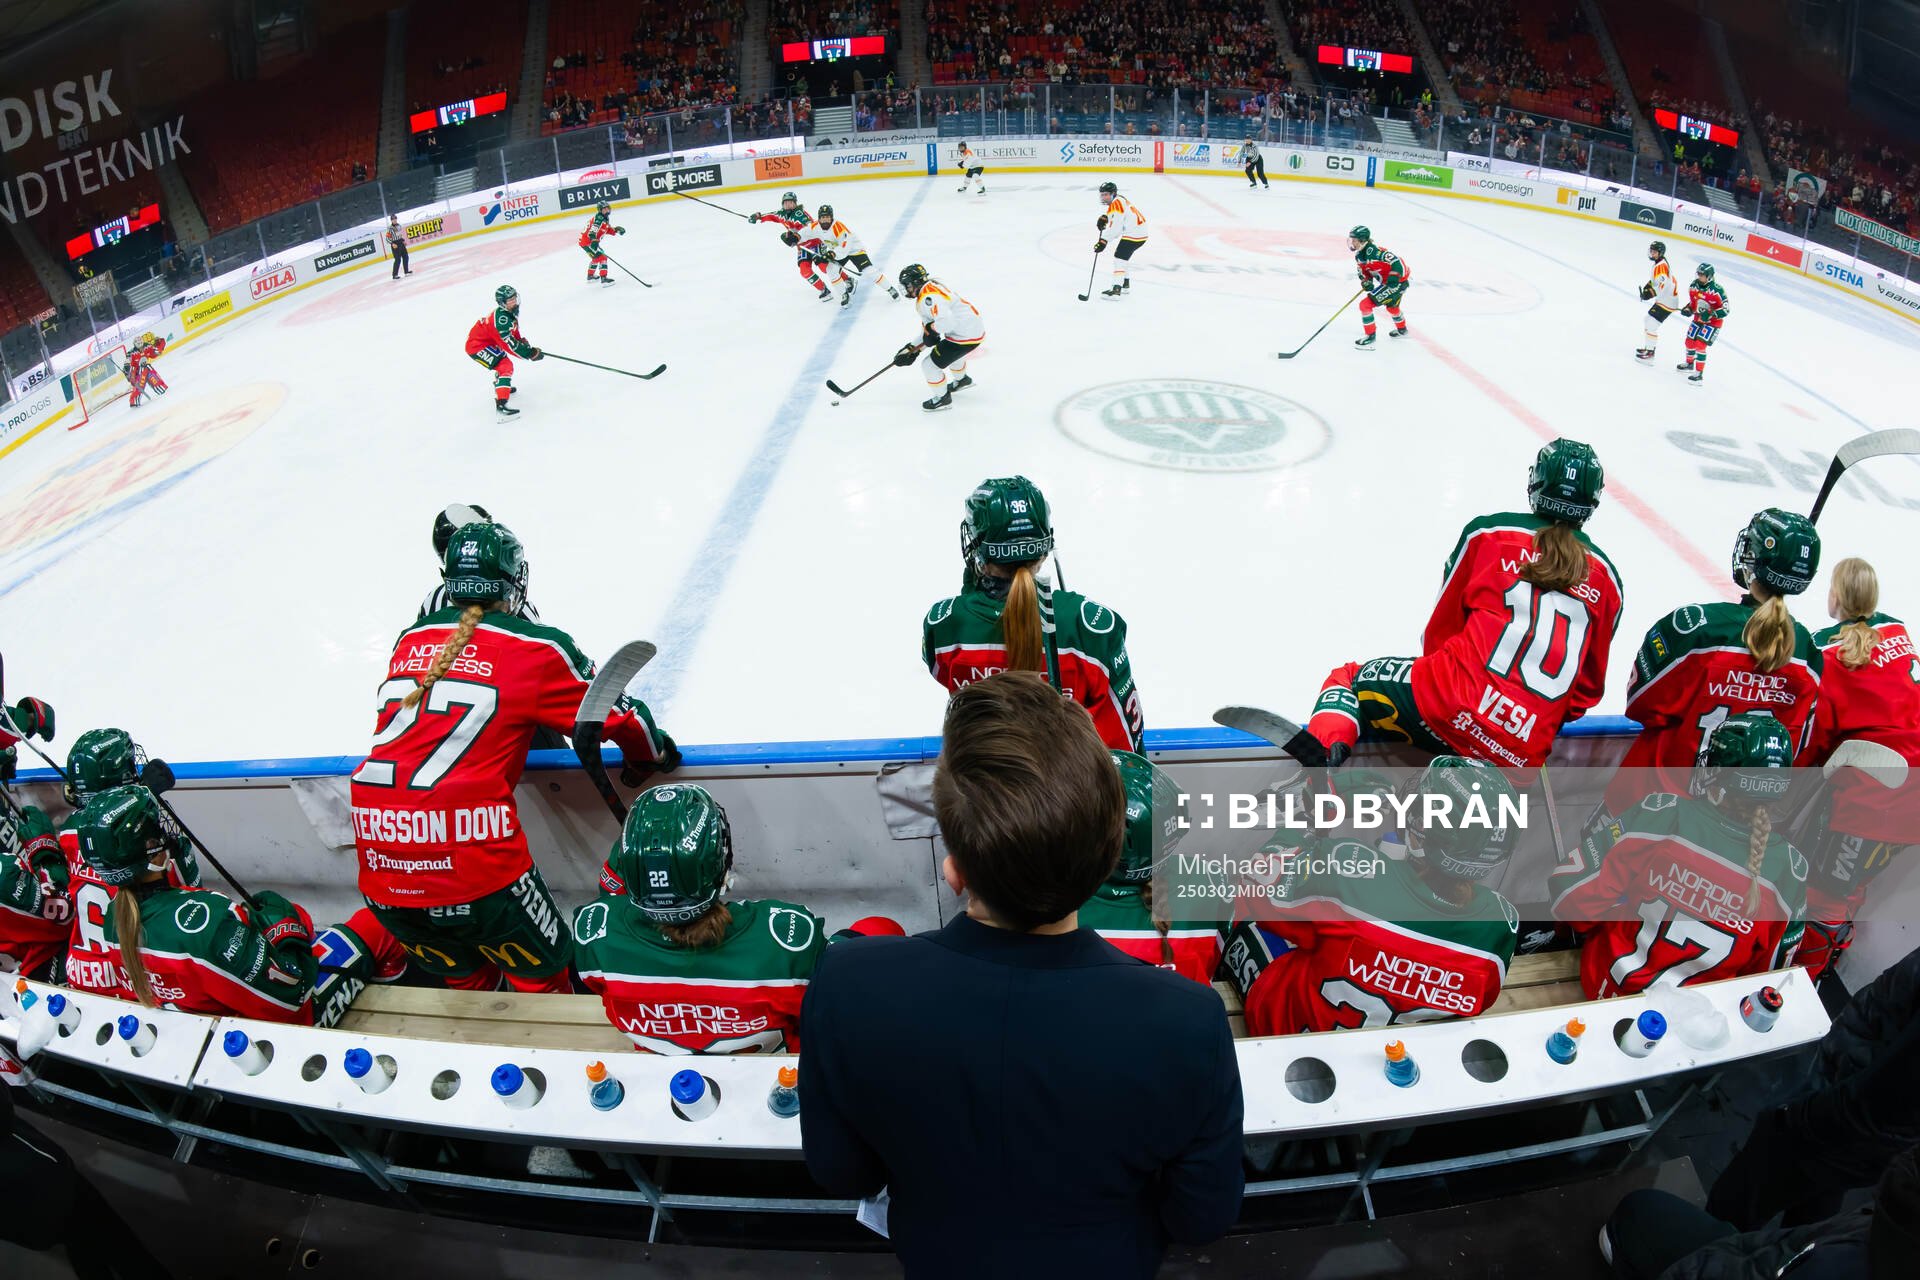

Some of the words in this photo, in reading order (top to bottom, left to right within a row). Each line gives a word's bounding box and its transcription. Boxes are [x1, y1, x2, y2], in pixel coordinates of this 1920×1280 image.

[833, 151, 908, 165] BYGGRUPPEN
[993, 147, 1037, 158] SERVICE
[1079, 143, 1142, 156] Safetytech
[1173, 155, 1211, 164] HAGMANS
[764, 157, 791, 172] ESS
[503, 194, 539, 211] INTER
[567, 184, 621, 204] BRIXLY
[504, 205, 540, 221] SPORT
[1839, 210, 1861, 231] MOT
[406, 218, 443, 240] SPORT
[353, 245, 373, 258] Bank
[254, 270, 295, 296] JULA
[1825, 264, 1864, 289] STENA
[193, 300, 229, 321] Ramudden
[8, 396, 52, 430] PROLOGIS
[1565, 467, 1577, 481] 10
[988, 540, 1049, 558] BJURFORS
[1800, 545, 1810, 559] 18
[1486, 579, 1592, 702] 10
[392, 657, 494, 677] WELLESS
[1726, 670, 1788, 690] NORDIC
[1708, 681, 1797, 706] WELLNESS
[1477, 684, 1538, 743] VESA
[349, 677, 499, 790] 27
[1470, 725, 1528, 768] Tranpenad
[75, 763, 80, 775] 6
[455, 805, 515, 842] DOVE
[1164, 815, 1178, 837] 26
[1490, 826, 1507, 843] 33
[378, 854, 454, 874] Tranpenad
[648, 870, 670, 888] 22
[1668, 862, 1745, 913] NORDIC
[510, 873, 560, 947] STENA
[1648, 869, 1754, 936] WELLNESS
[585, 906, 597, 938] VOLVO
[786, 913, 797, 944] VOLVO
[1608, 898, 1737, 990] 17
[1373, 950, 1465, 991] NORDIC
[1349, 958, 1478, 1013] WELLNESS
[638, 1002, 741, 1021] NORDIC
[619, 1015, 768, 1035] WELLNESS
